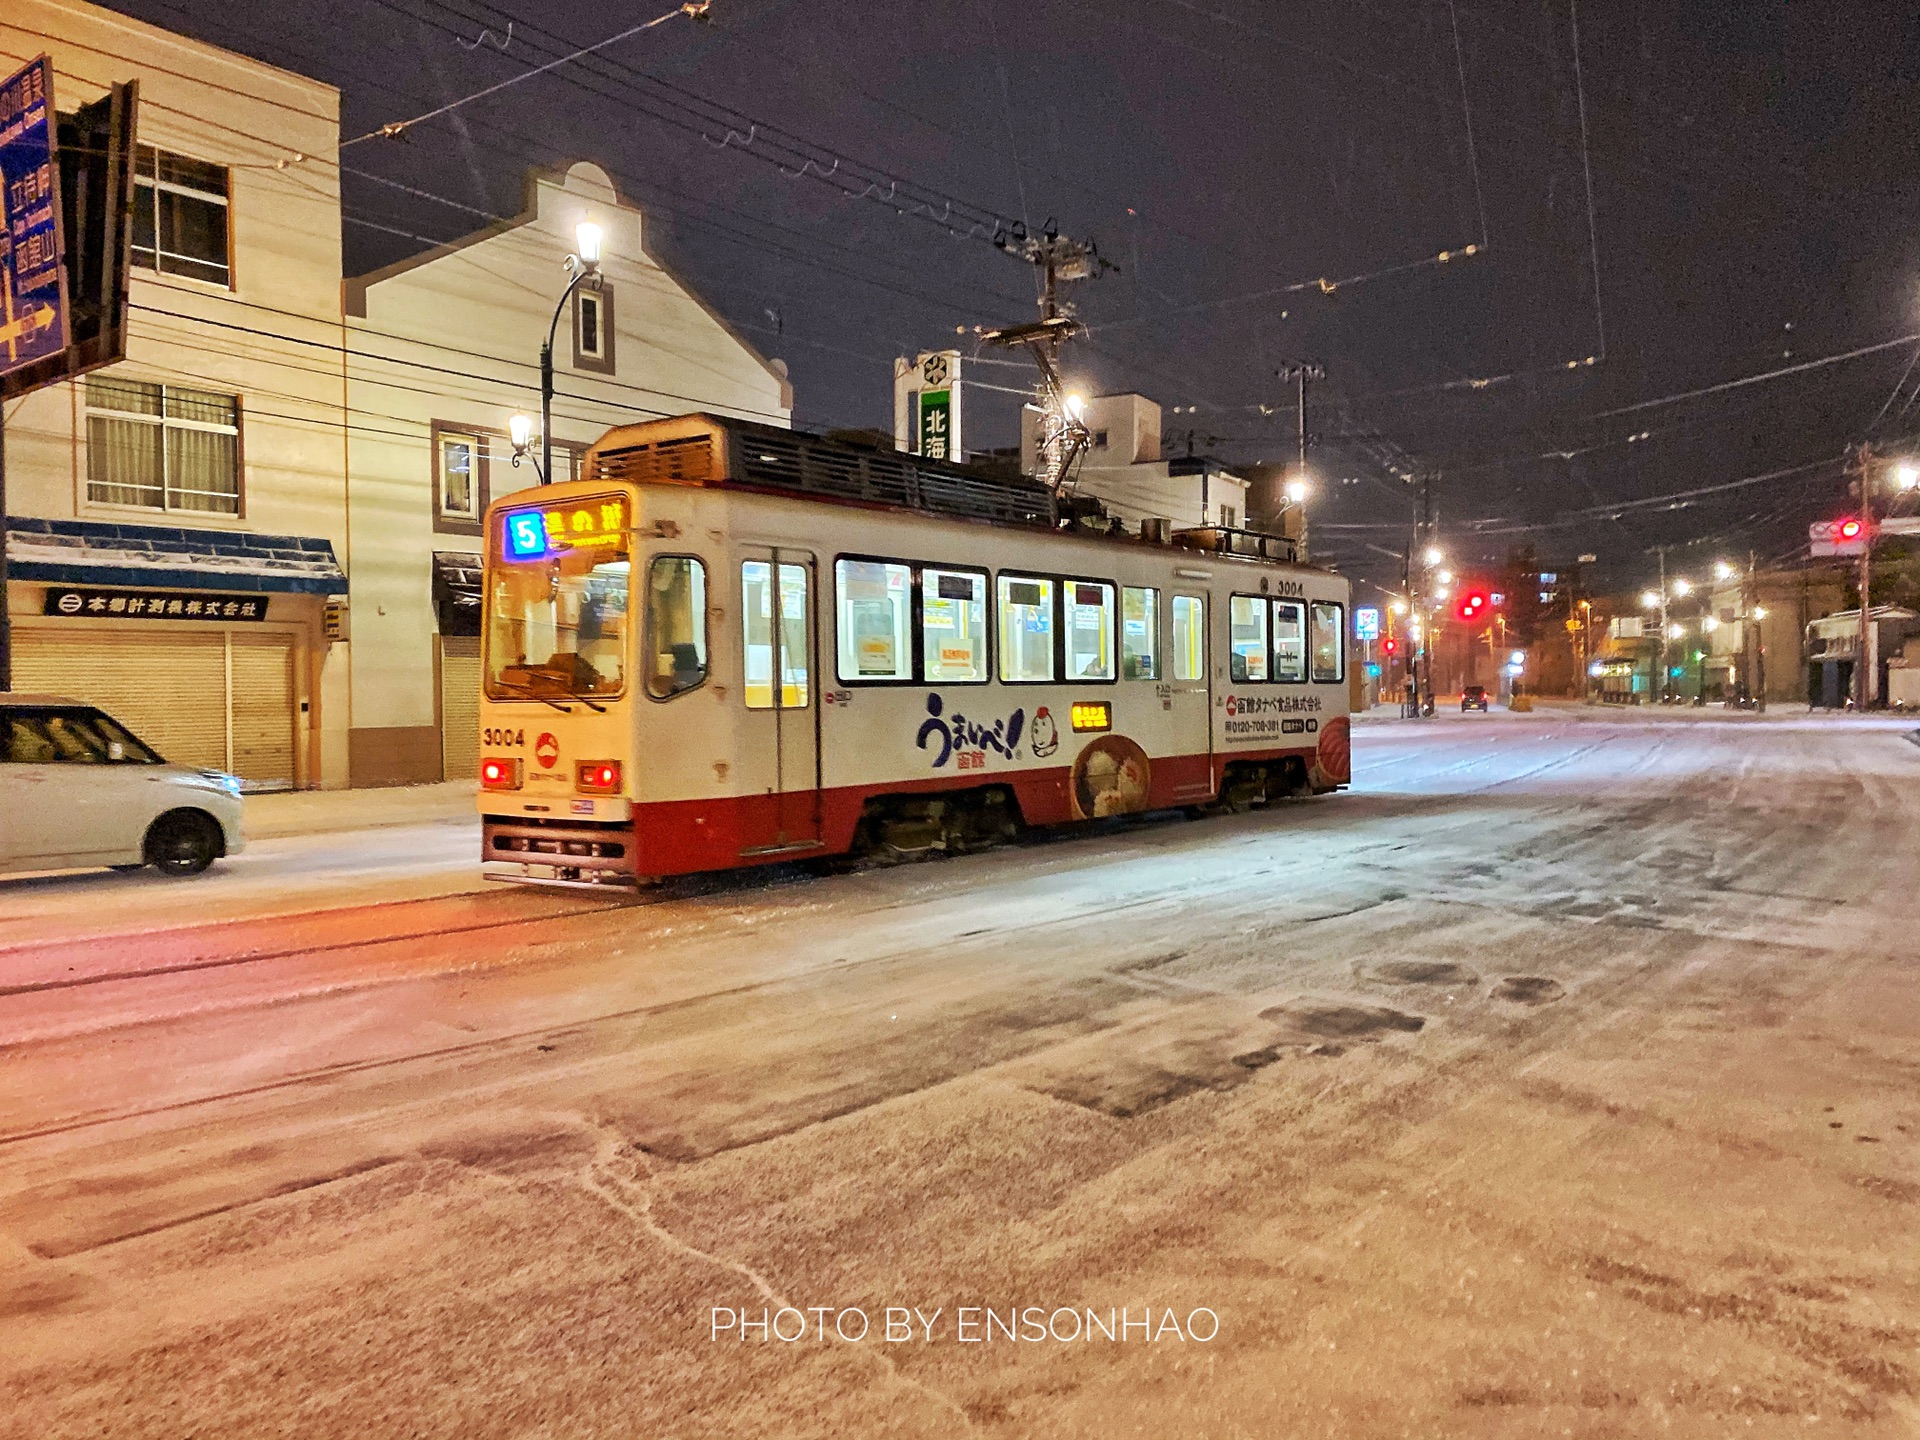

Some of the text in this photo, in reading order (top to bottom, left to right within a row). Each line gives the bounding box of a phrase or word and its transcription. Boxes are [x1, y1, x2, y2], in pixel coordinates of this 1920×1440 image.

[516, 519, 537, 549] 5
[1277, 580, 1303, 597] 3004
[1237, 696, 1322, 714] 函館タナベ食品株式会社
[483, 728, 525, 747] 3004
